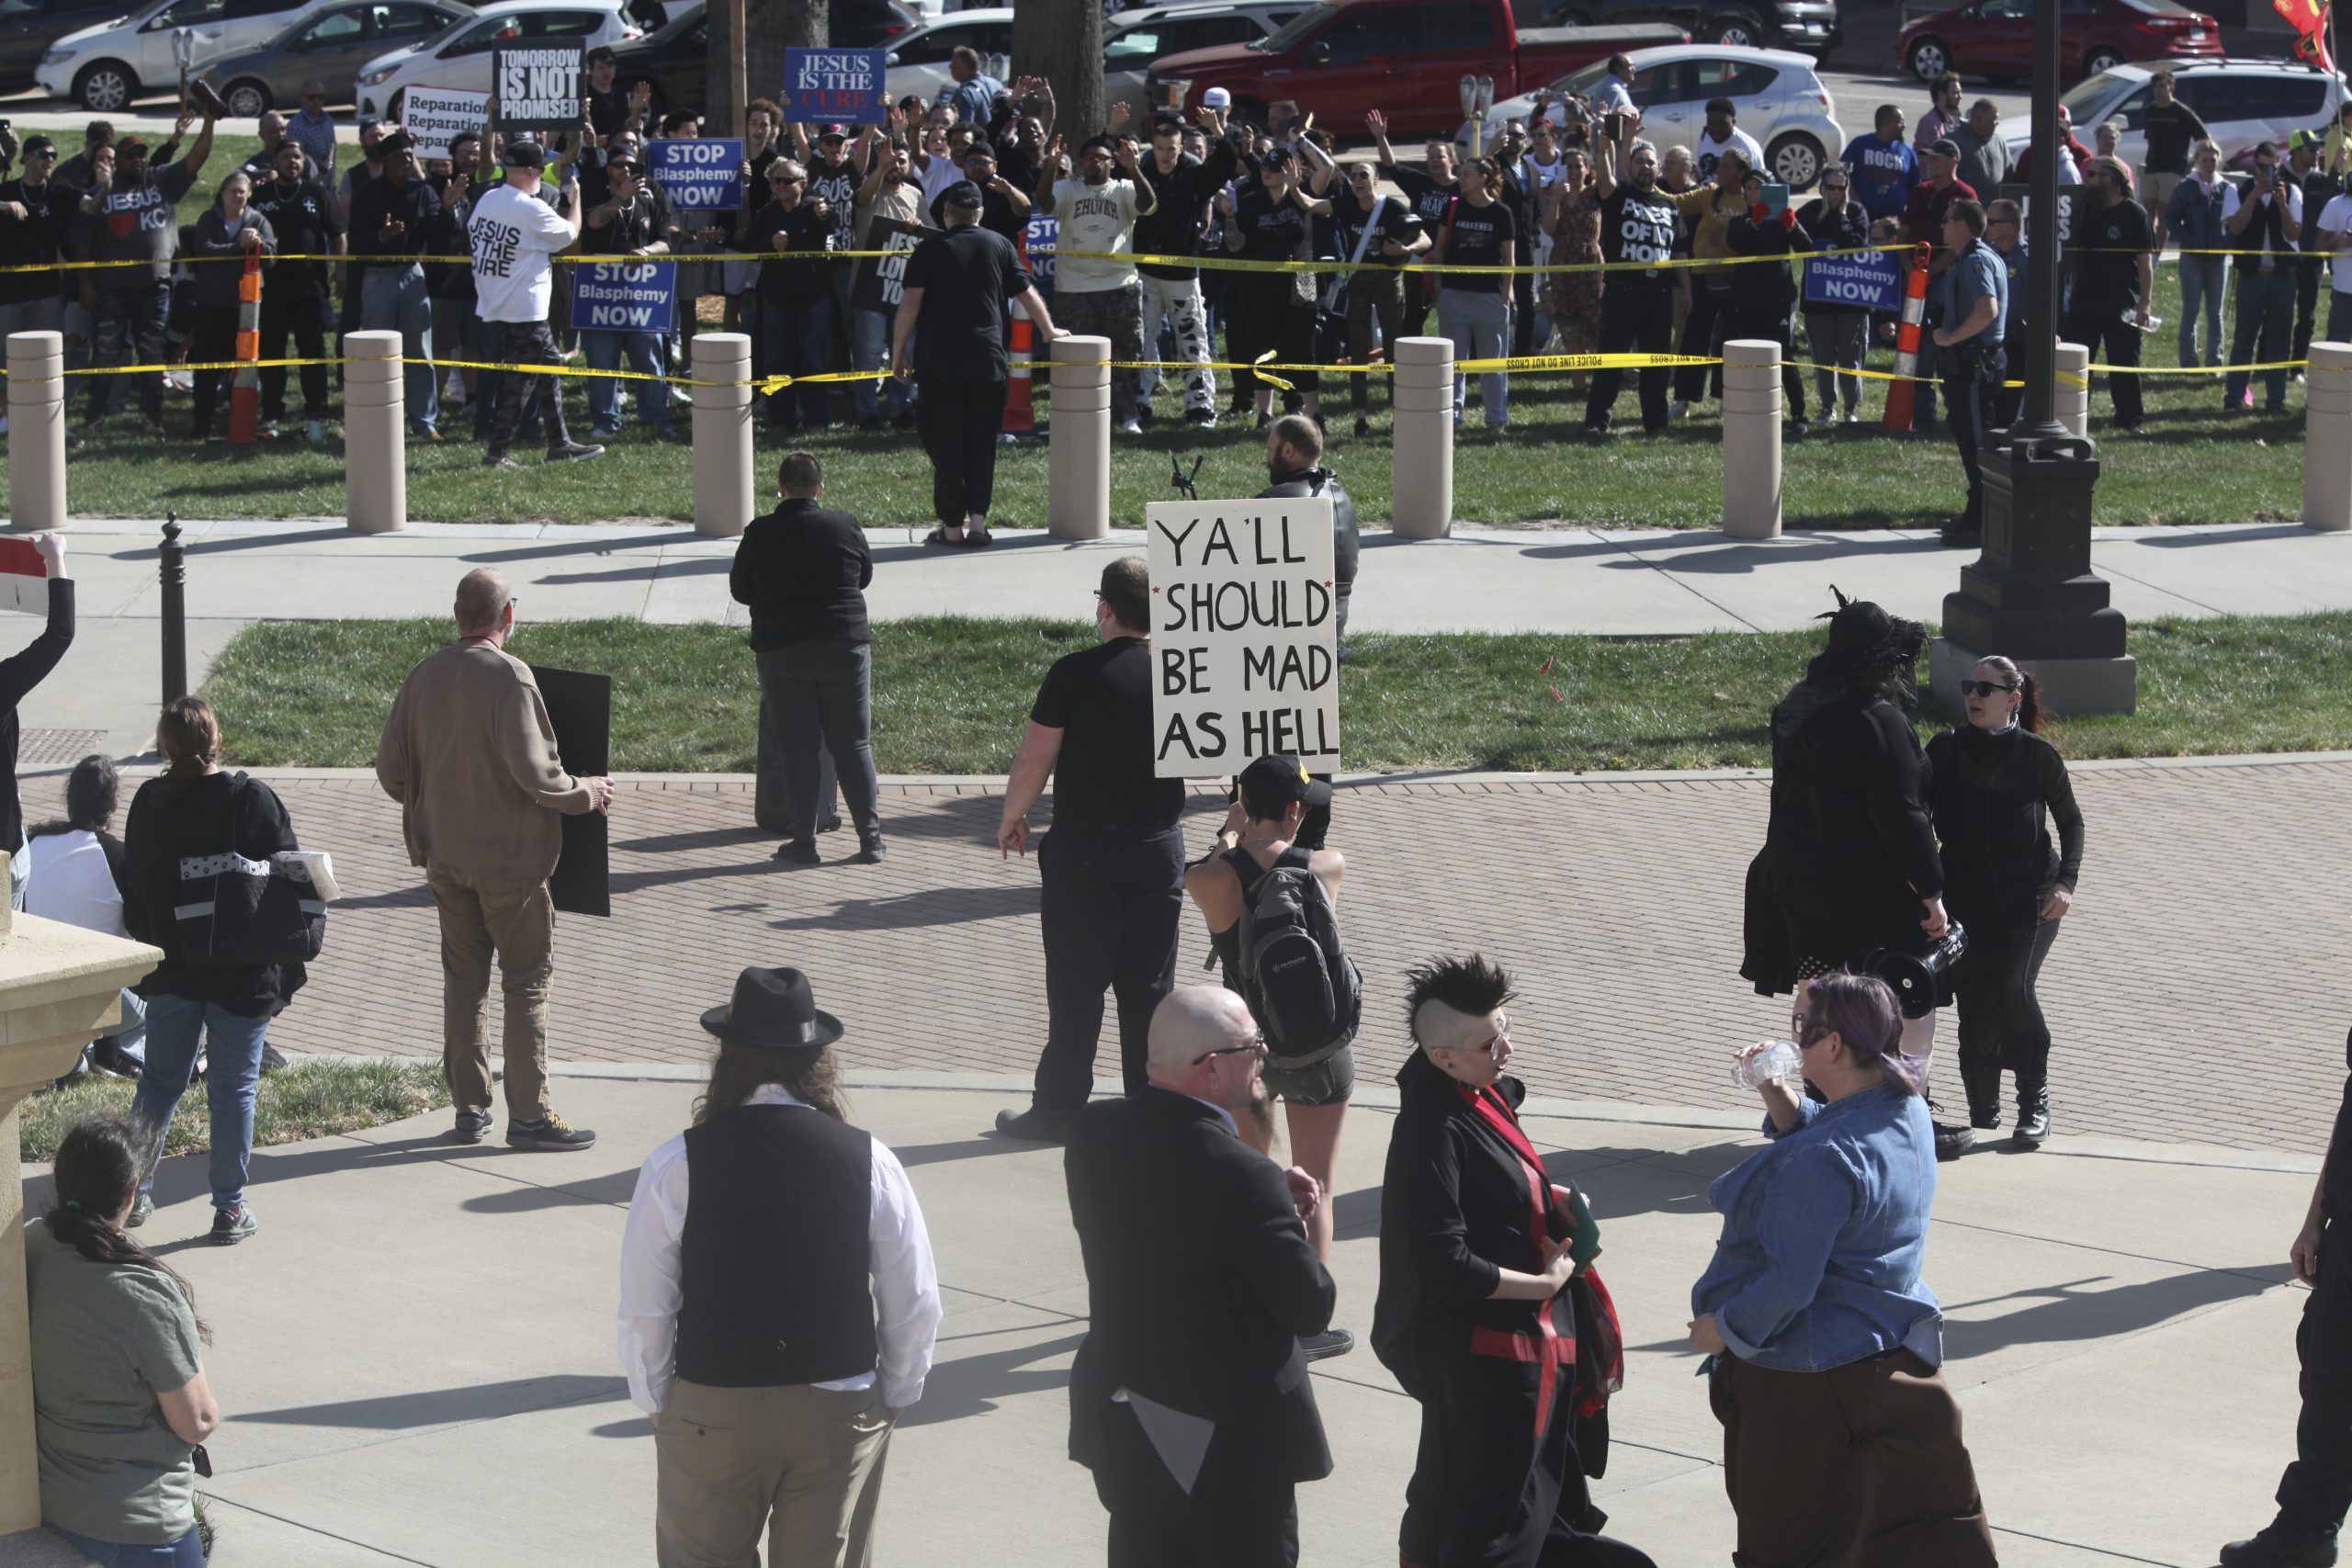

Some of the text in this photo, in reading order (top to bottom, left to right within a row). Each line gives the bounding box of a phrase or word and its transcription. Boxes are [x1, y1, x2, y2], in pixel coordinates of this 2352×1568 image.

[500, 49, 581, 68] TOMORROW
[800, 54, 870, 73] JESUS
[500, 67, 581, 99] IS NOT
[797, 73, 873, 90] IS THE
[500, 99, 579, 119] PROMISED
[801, 89, 867, 108] CURE
[667, 144, 725, 164] STOP
[1864, 149, 1904, 171] ROCK
[653, 167, 738, 184] Blasphemy
[103, 186, 162, 214] JESUS
[667, 186, 723, 206] NOW
[141, 208, 165, 231] KC
[1622, 220, 1652, 241] OF
[469, 217, 521, 246] JESUS
[471, 234, 516, 262] S THE
[882, 231, 923, 258] JES
[1621, 241, 1671, 264] HOM
[1825, 243, 1883, 265] STOP
[594, 261, 658, 283] STOP
[1812, 262, 1896, 286] Blasphemy
[579, 284, 669, 304] Blasphemy
[1826, 280, 1882, 303] NOW
[592, 305, 652, 327] NOW
[1507, 356, 1601, 370] POLICE LINE DO NOT CROSS
[1650, 355, 1674, 364] CROSS
[1155, 516, 1306, 566] YA'LL
[1163, 580, 1329, 632] SHOULD
[1161, 645, 1331, 695] BE MAD
[1157, 707, 1340, 760] AS HELL
